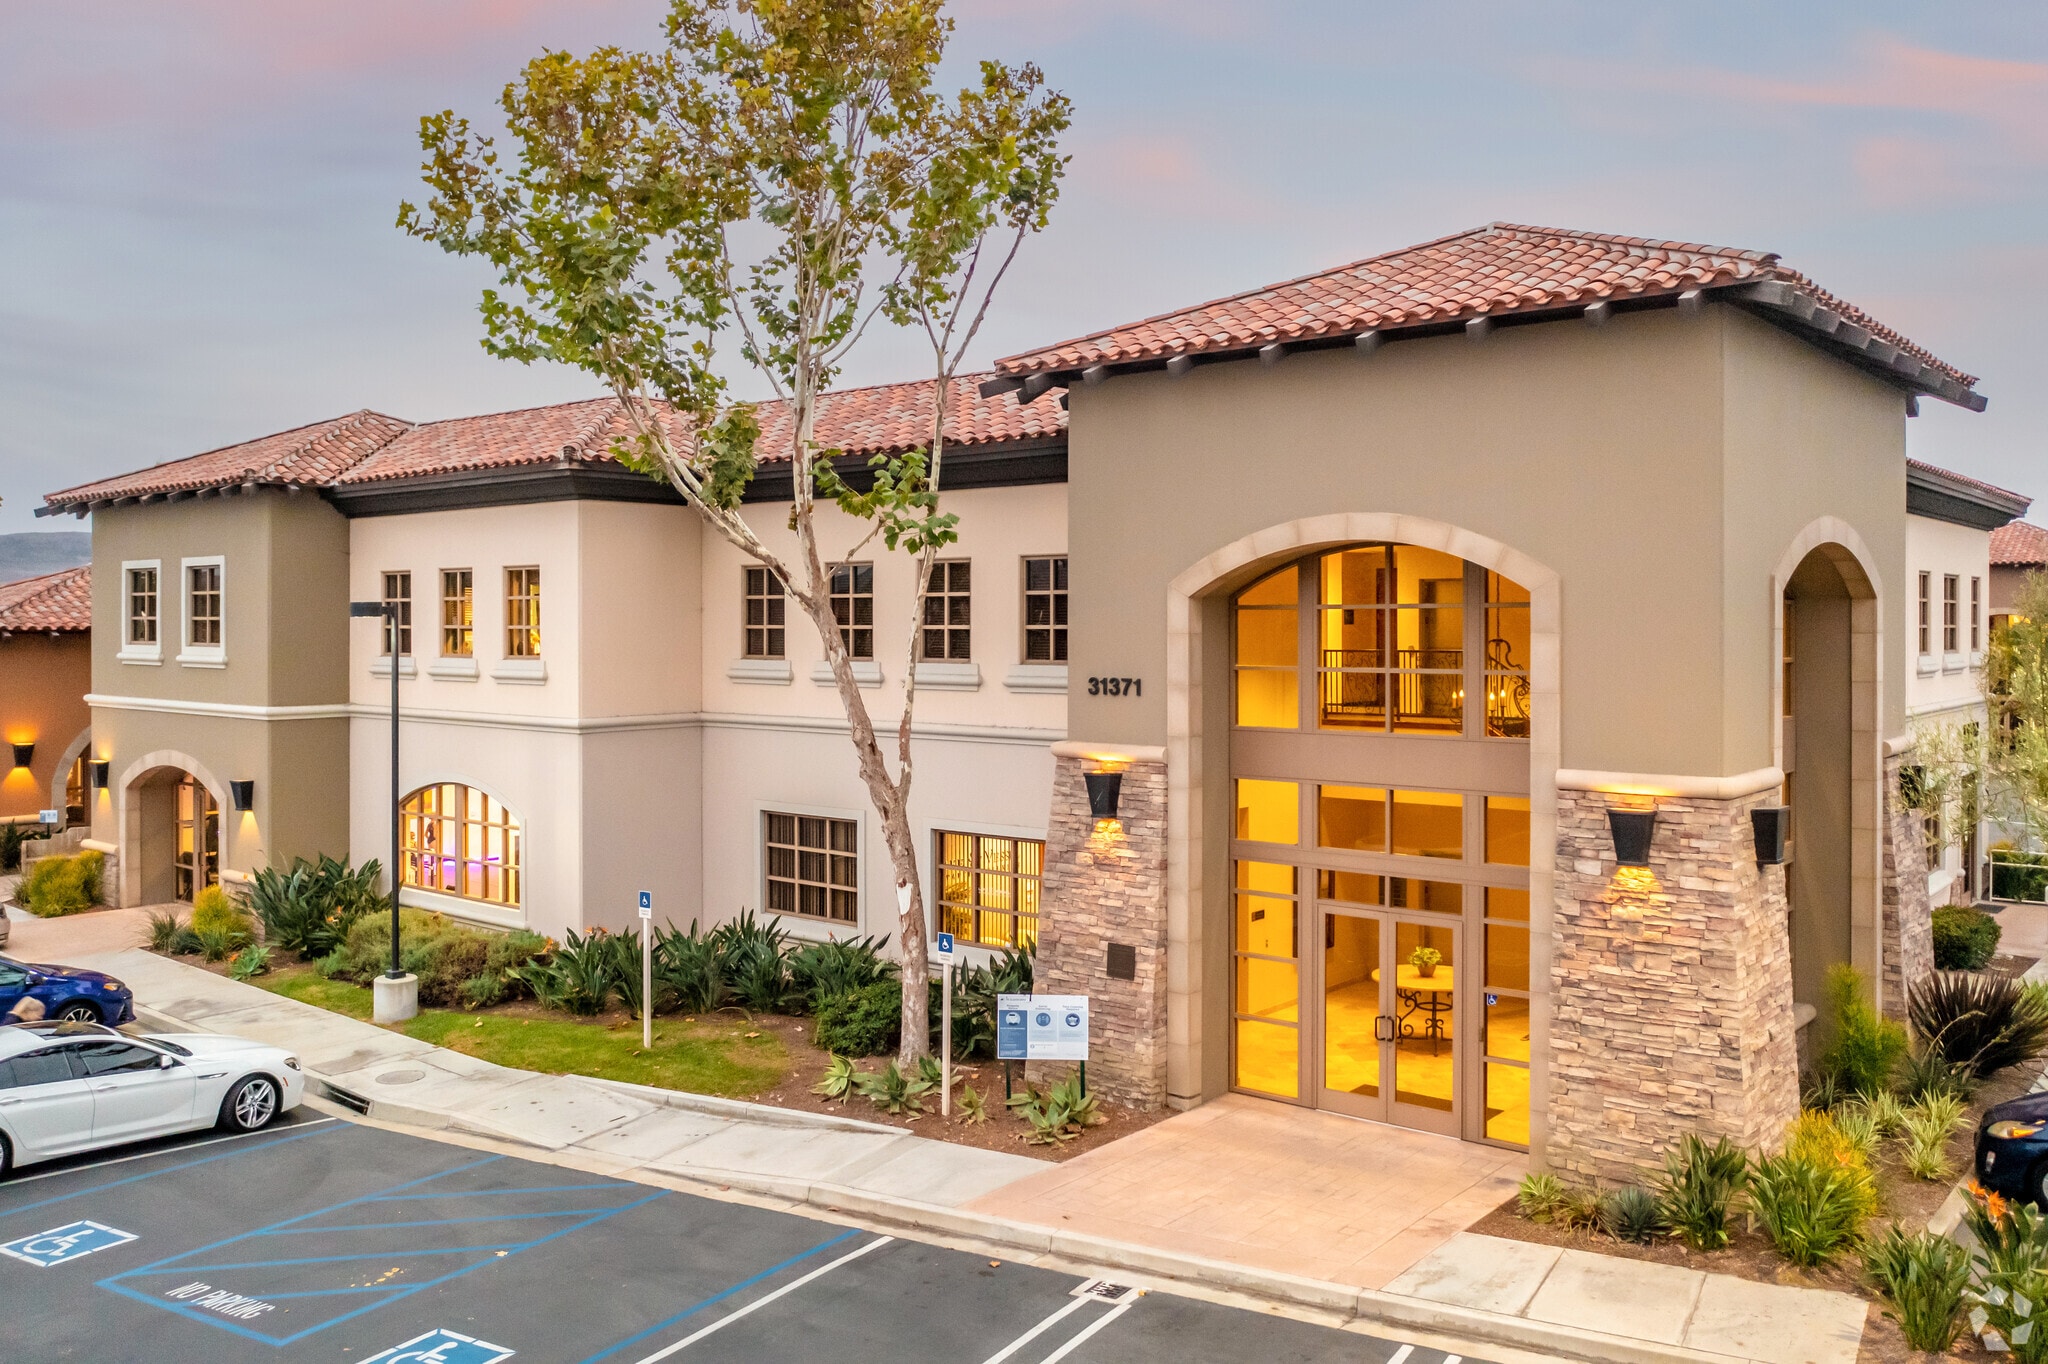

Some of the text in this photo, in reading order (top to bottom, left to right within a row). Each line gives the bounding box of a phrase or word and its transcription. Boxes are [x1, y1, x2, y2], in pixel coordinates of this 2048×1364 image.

[1088, 677, 1142, 697] 31371
[164, 1281, 276, 1320] NO PARKING
